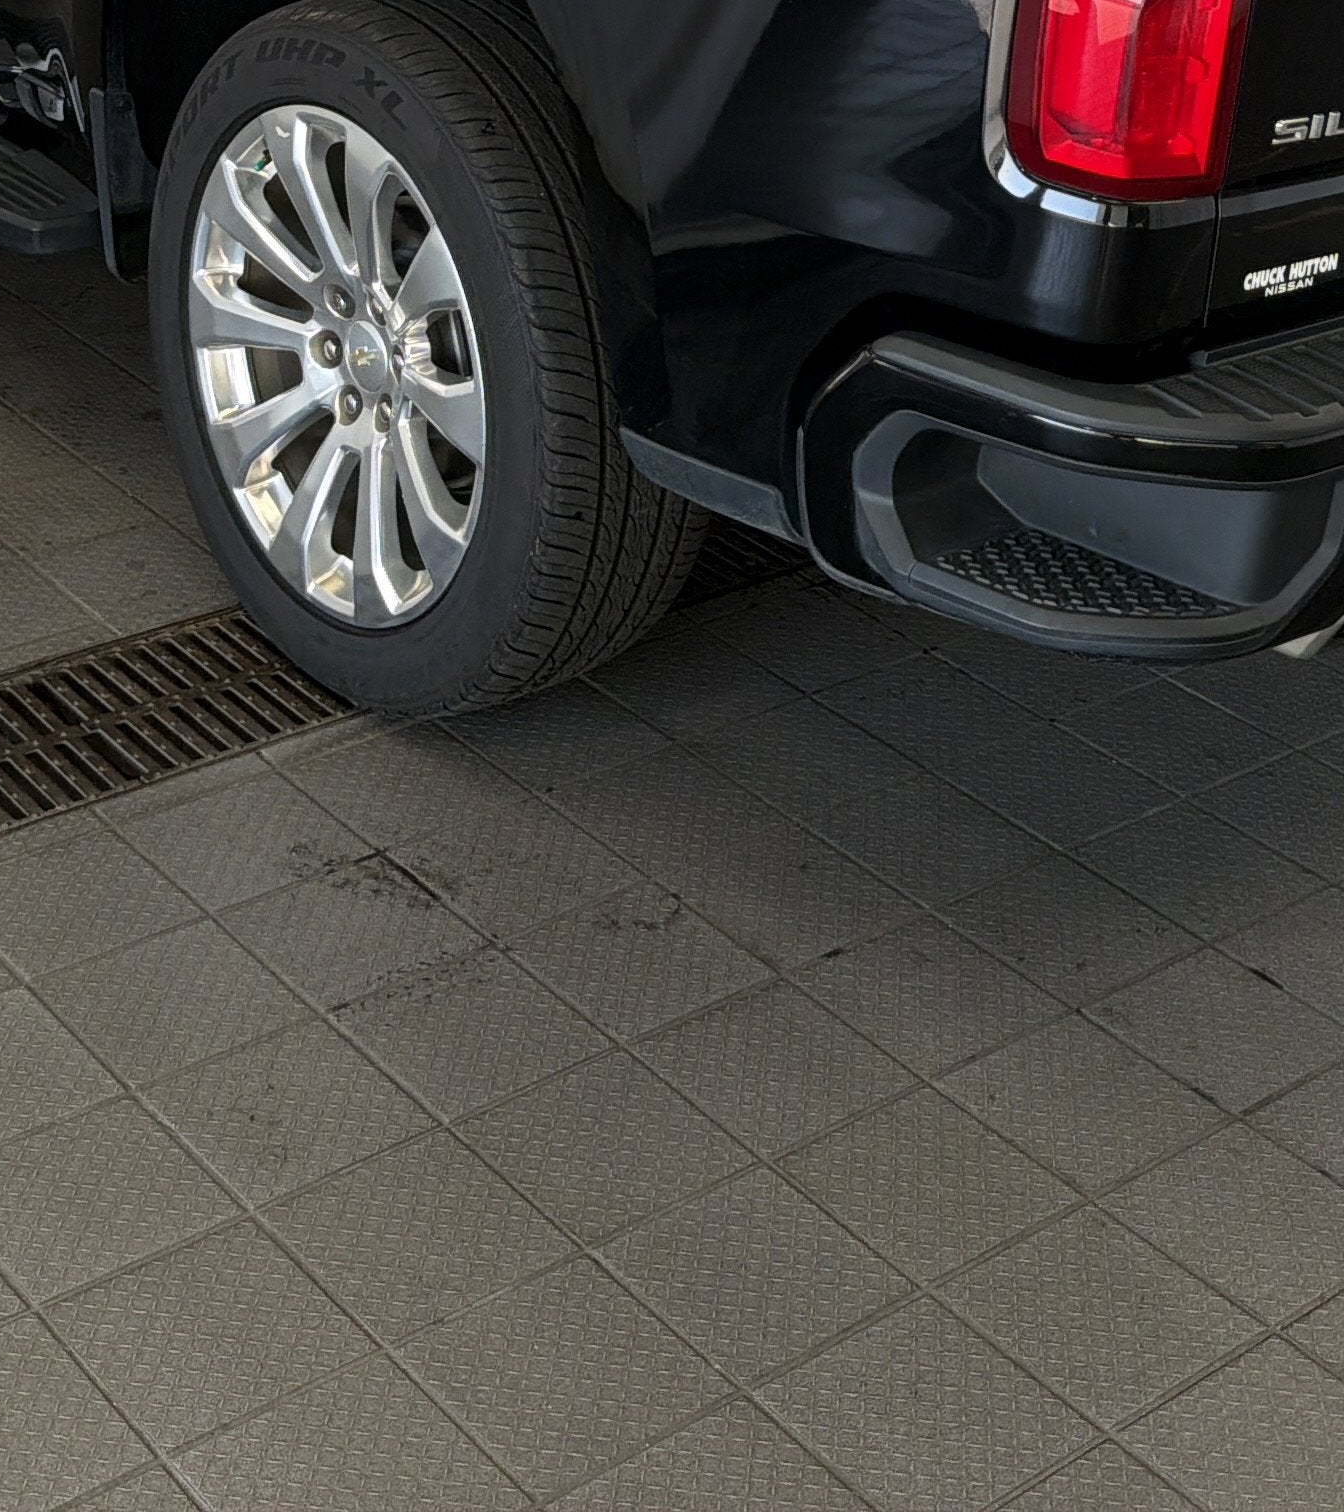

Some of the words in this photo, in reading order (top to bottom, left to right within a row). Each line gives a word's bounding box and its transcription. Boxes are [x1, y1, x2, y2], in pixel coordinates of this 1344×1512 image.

[256, 38, 347, 68] UHP
[354, 66, 408, 130] XL
[1243, 265, 1287, 291] CHUCK
[1288, 252, 1339, 280] HUTTON
[1264, 276, 1314, 298] NISSAN
